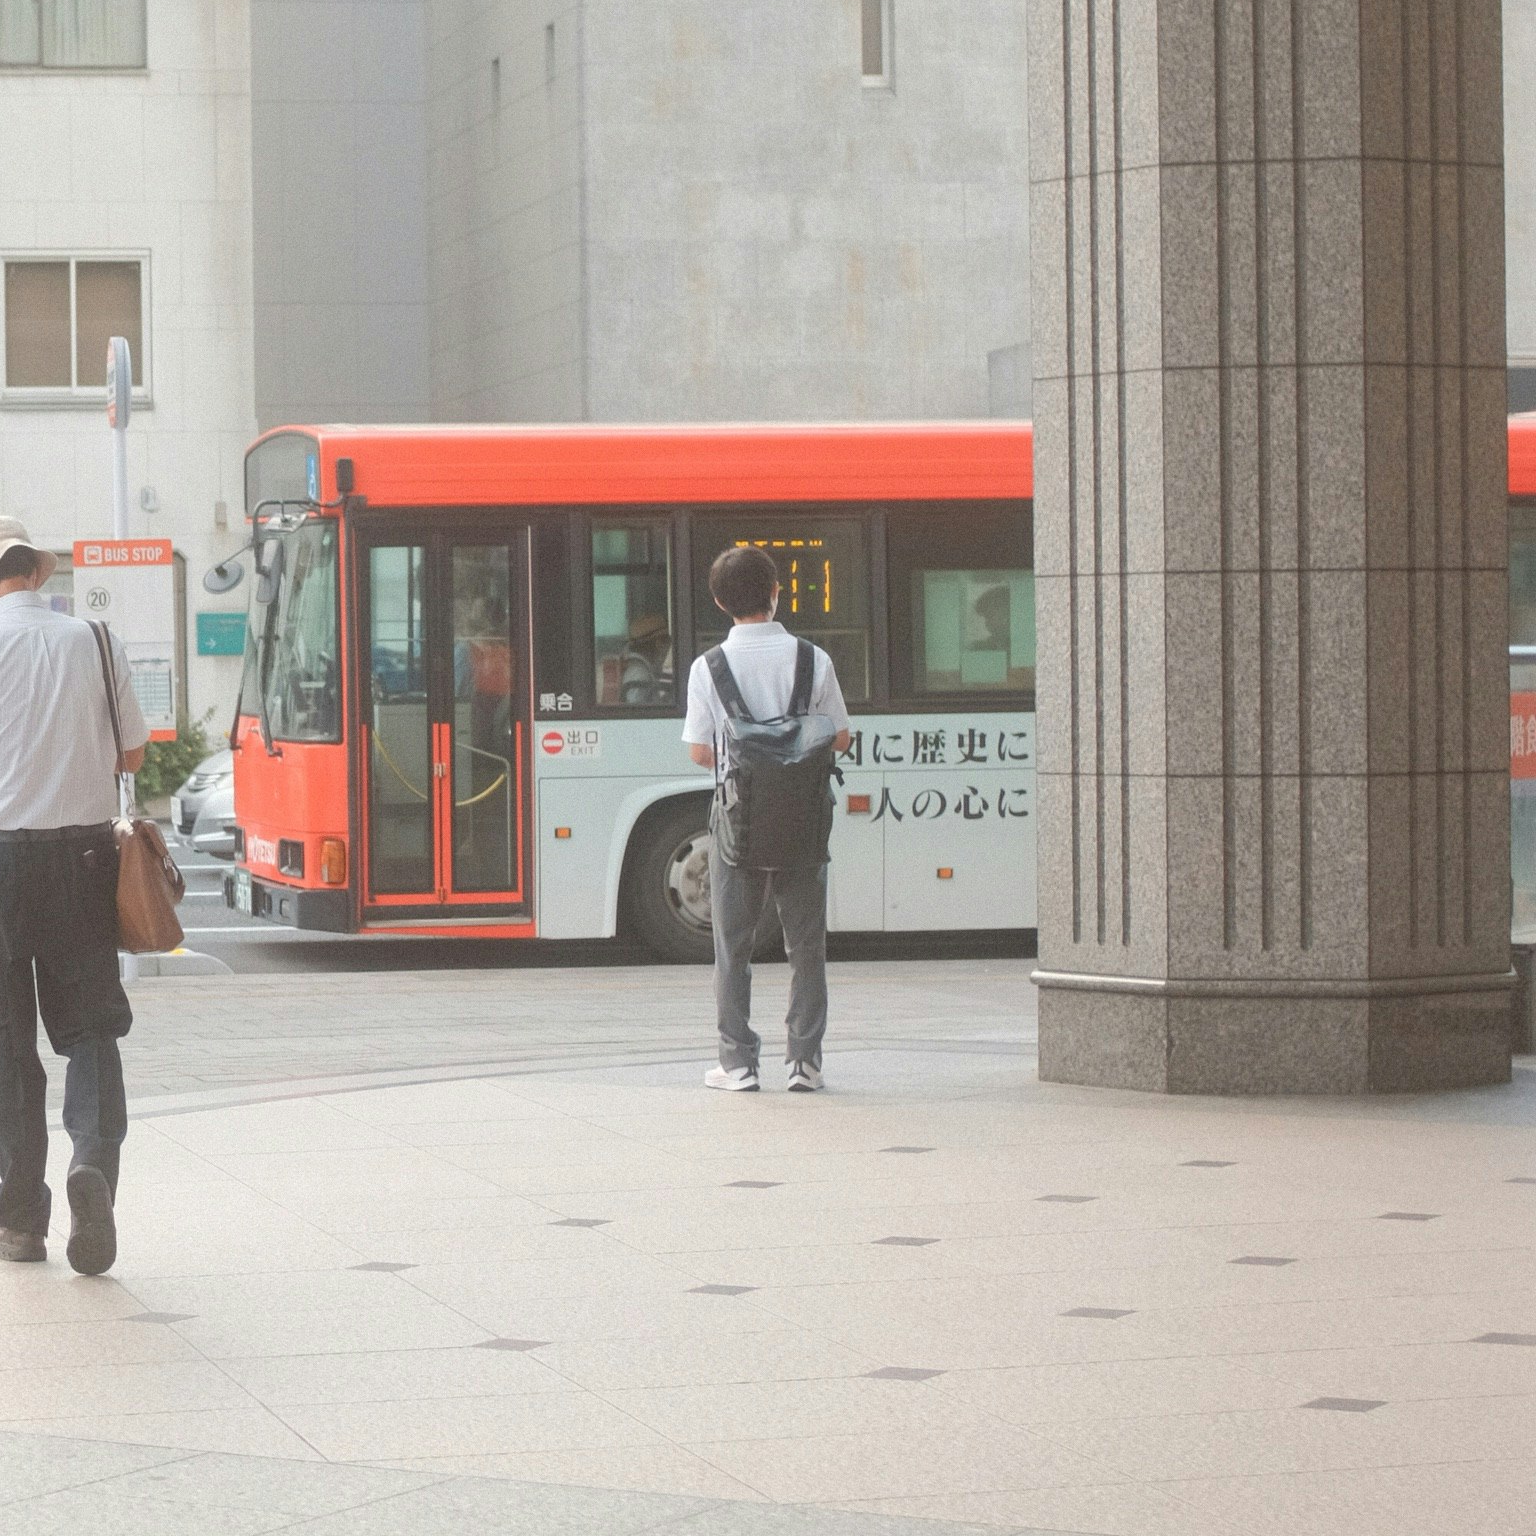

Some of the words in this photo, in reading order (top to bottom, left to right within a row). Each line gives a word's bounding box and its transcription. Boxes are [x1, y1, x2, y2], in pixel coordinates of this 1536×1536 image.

[104, 547, 129, 562] BUS
[132, 546, 163, 561] STOP
[90, 591, 107, 607] 20
[567, 730, 599, 744] 出口
[571, 746, 595, 755] EXIT
[871, 785, 1029, 823] 人の心に
